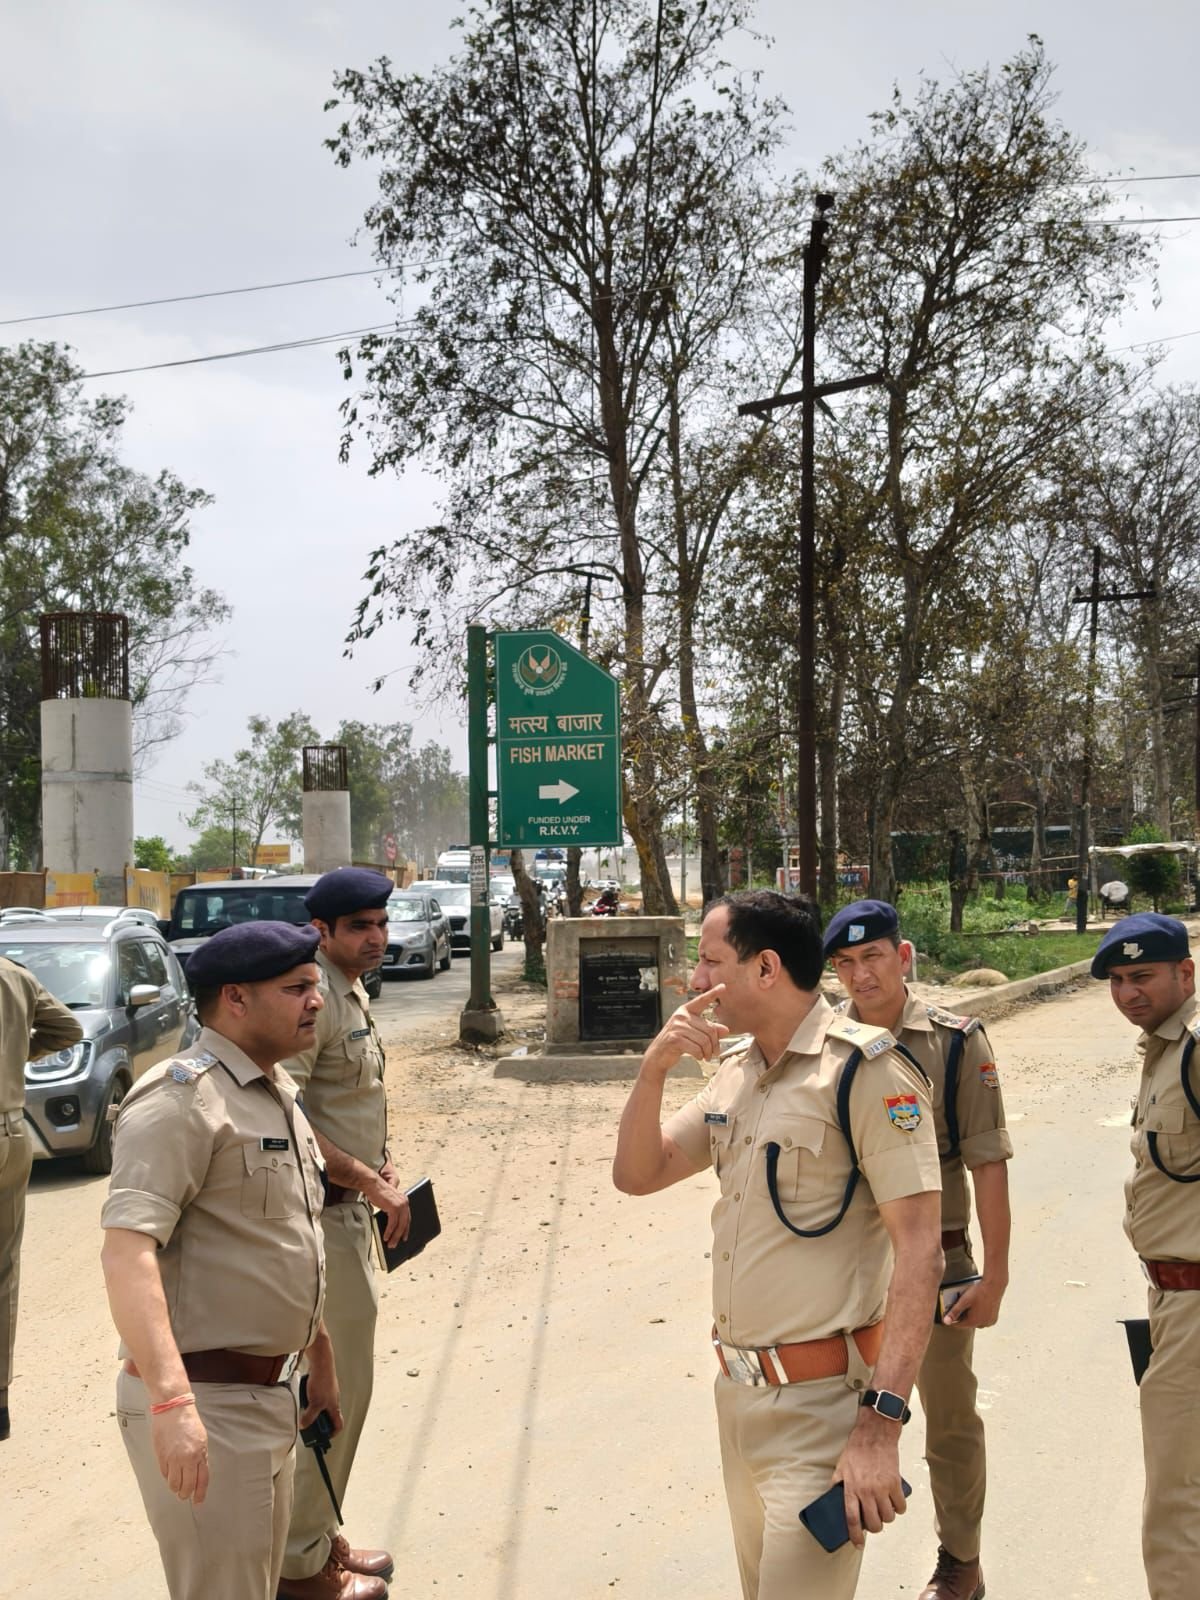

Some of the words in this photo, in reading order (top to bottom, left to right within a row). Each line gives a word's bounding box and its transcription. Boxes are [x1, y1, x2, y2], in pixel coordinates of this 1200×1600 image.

[508, 716, 549, 734] मत्स्य
[555, 713, 603, 732] बाजार
[510, 746, 542, 764] FISH
[545, 743, 605, 762] MARKET
[528, 816, 560, 825] FUNDED
[562, 815, 591, 824] UNDER
[539, 825, 580, 836] R.K.V.Y.
